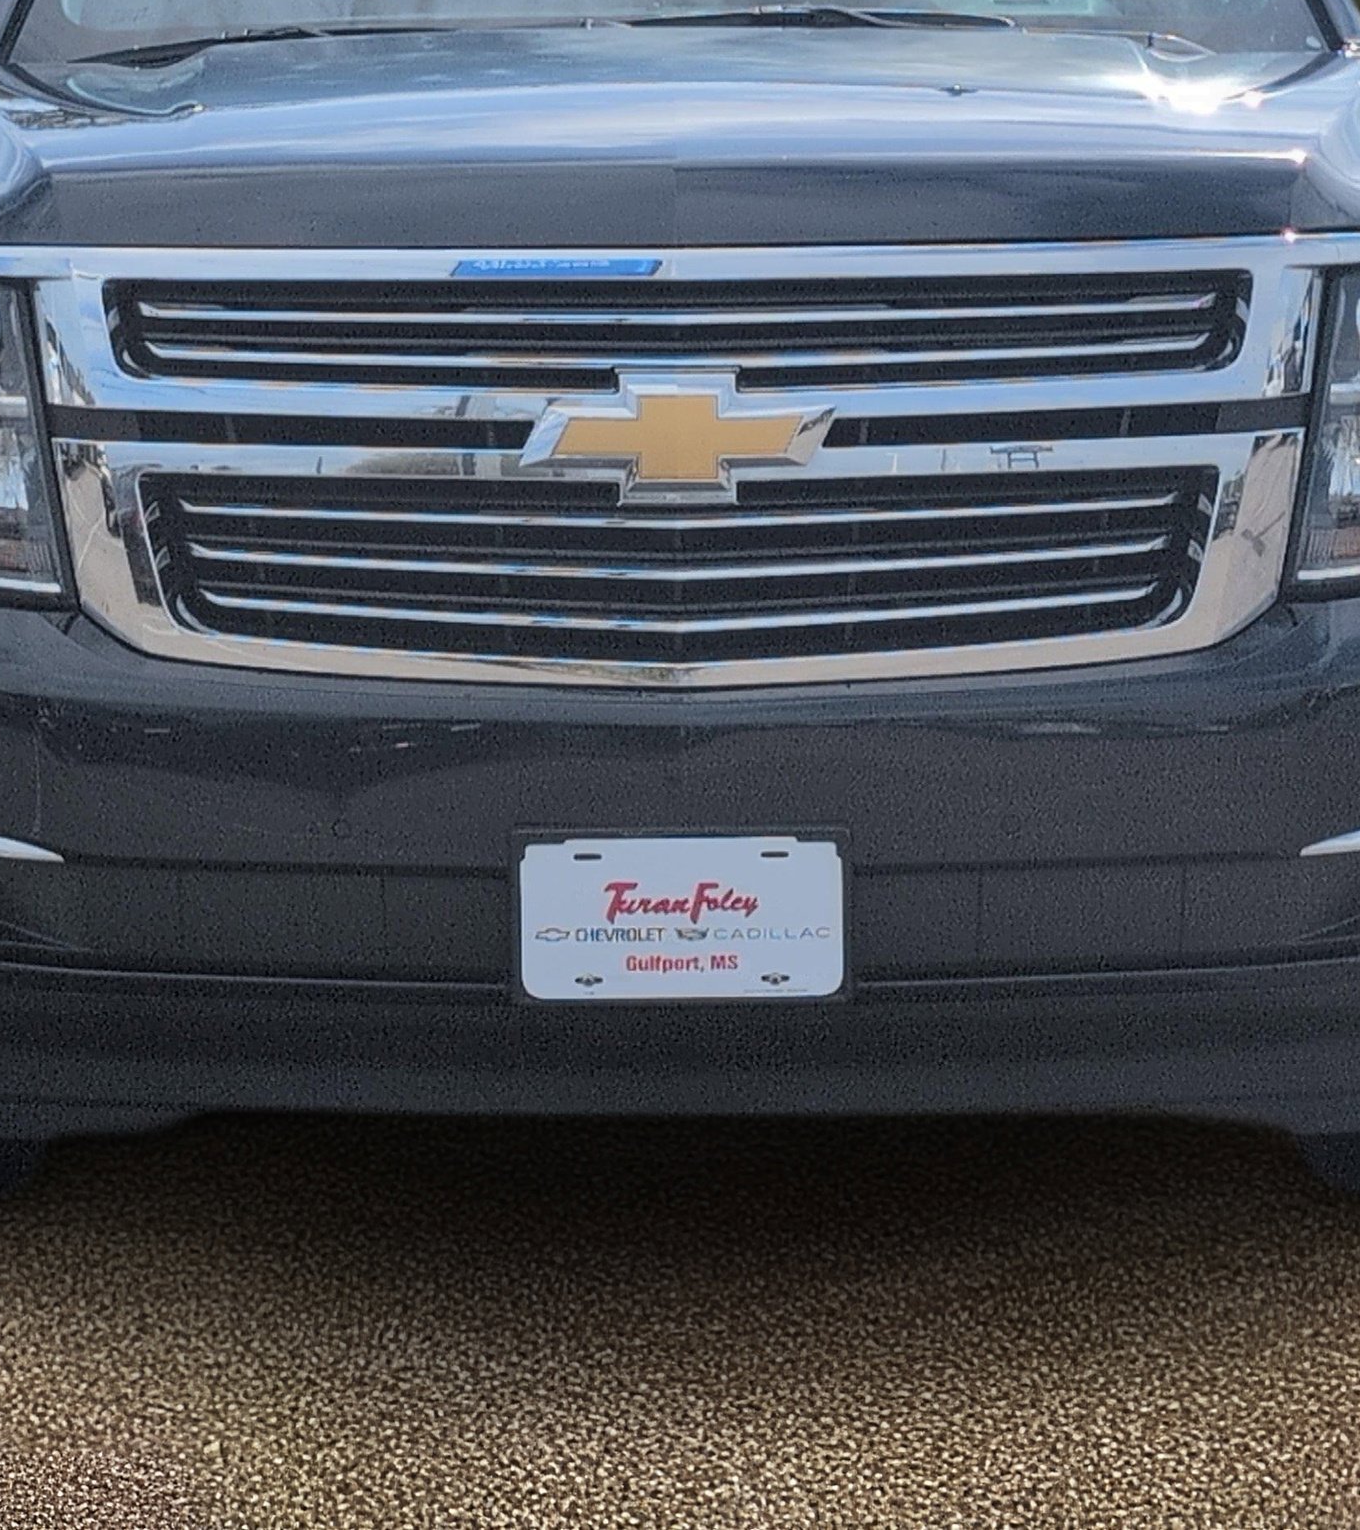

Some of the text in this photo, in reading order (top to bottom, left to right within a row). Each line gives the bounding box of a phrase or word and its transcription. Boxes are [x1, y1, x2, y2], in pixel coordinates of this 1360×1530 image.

[574, 926, 831, 942] CHEVROLET CADILLAC
[625, 953, 739, 974] Gulfport, MS
